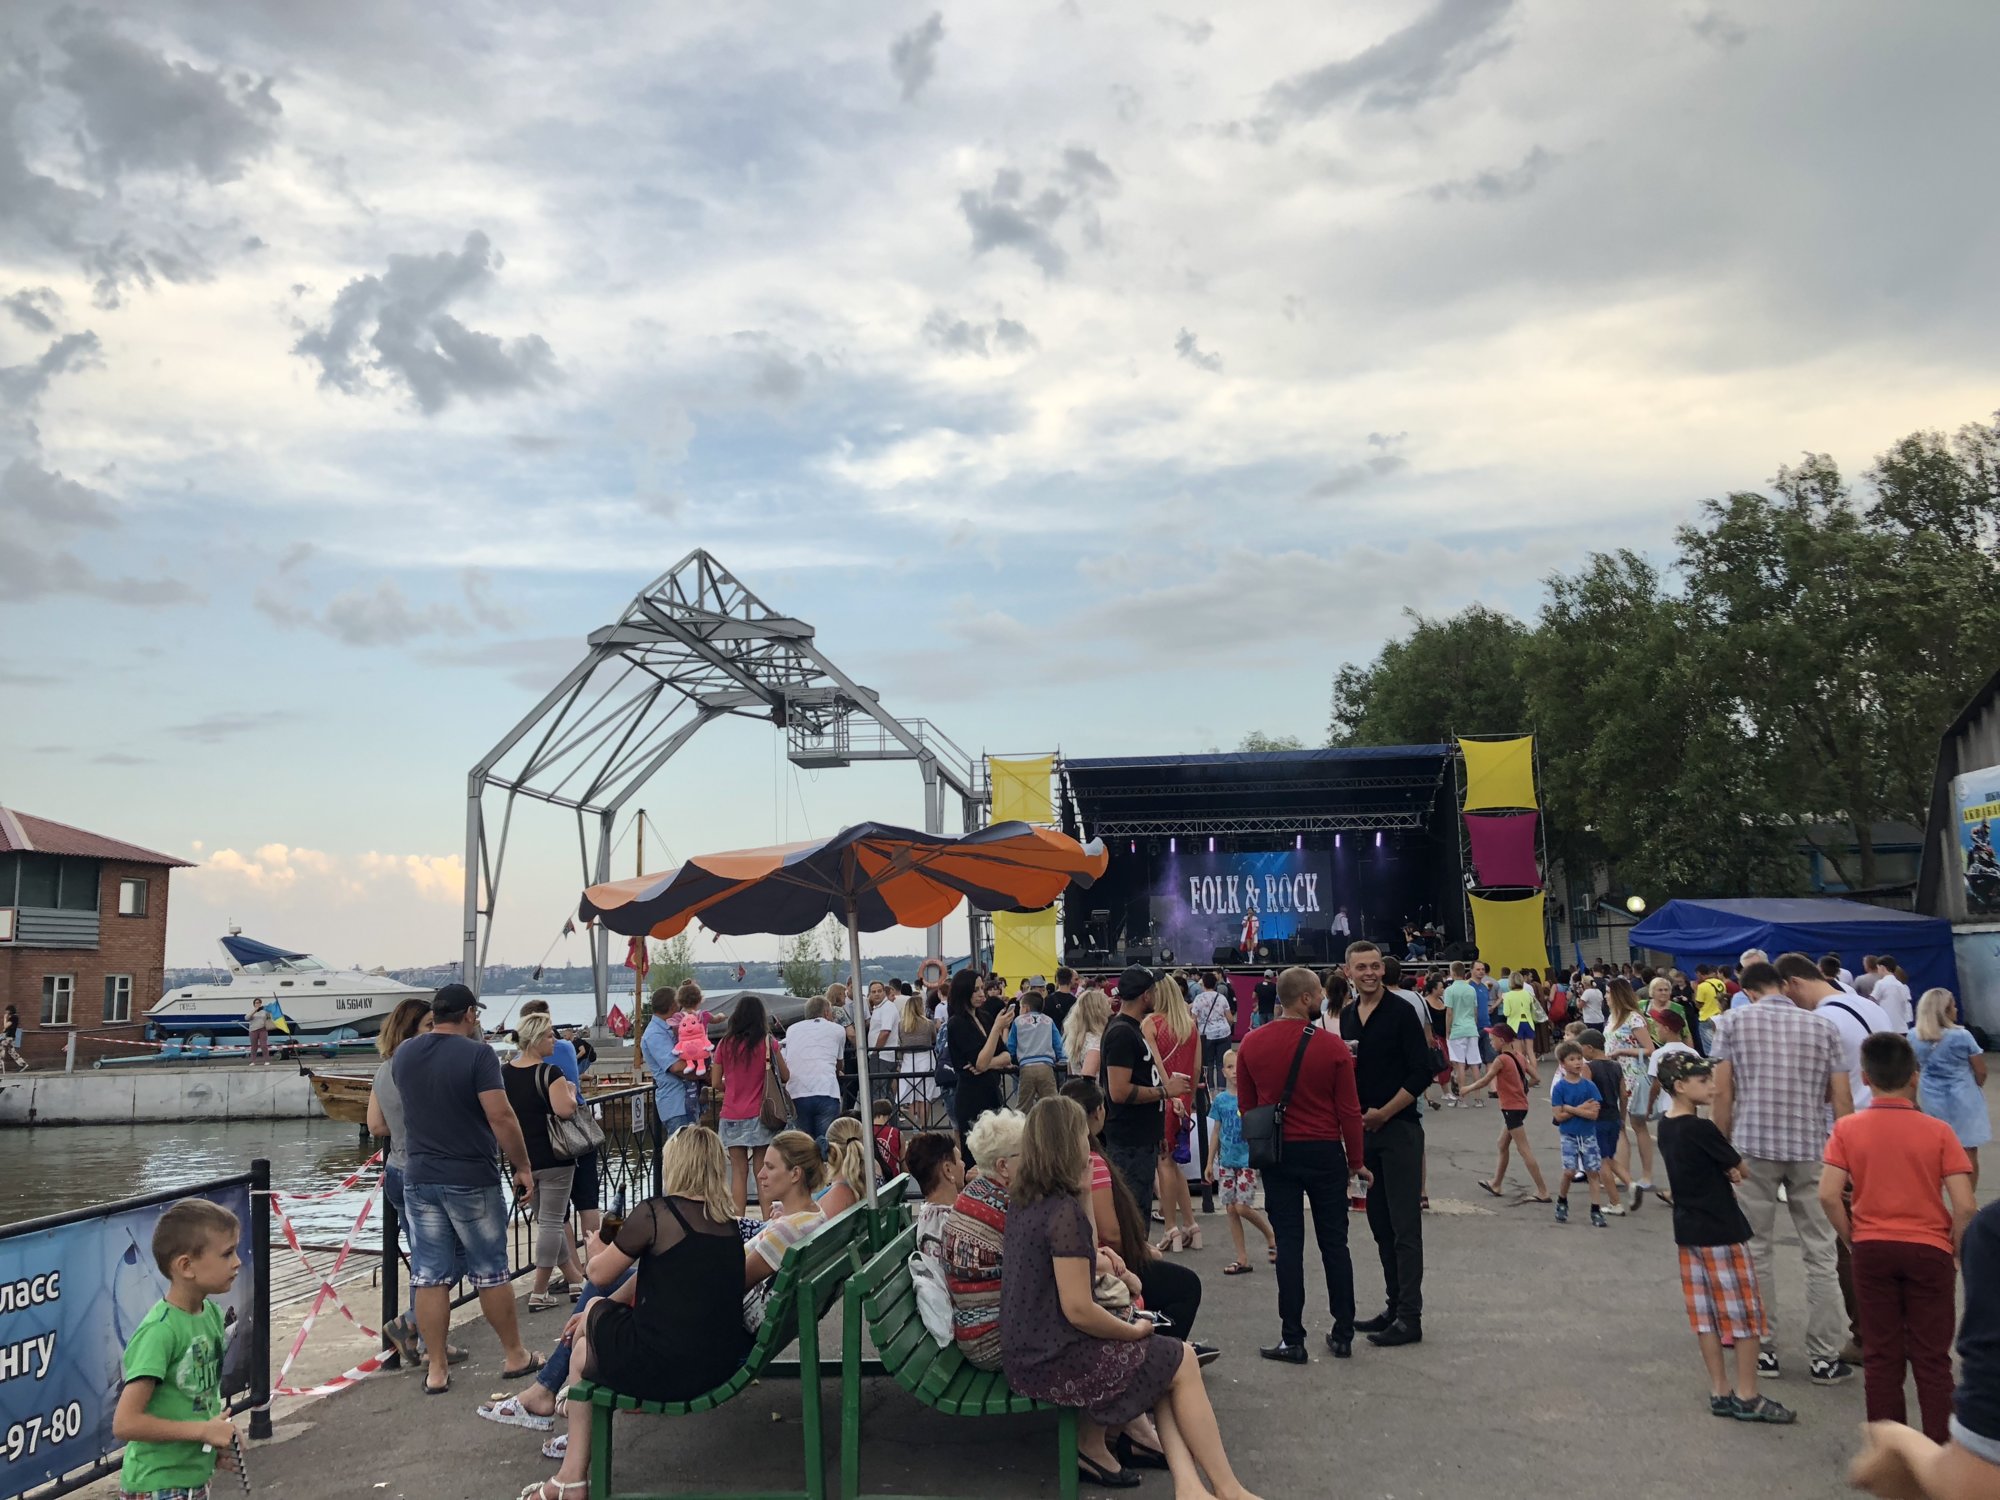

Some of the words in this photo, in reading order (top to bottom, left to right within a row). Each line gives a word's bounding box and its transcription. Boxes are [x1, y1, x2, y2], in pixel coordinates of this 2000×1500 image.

[1189, 875, 1241, 914] FOLK
[1245, 875, 1260, 913] &
[1265, 873, 1320, 912] ROCK
[336, 998, 346, 1010] UA
